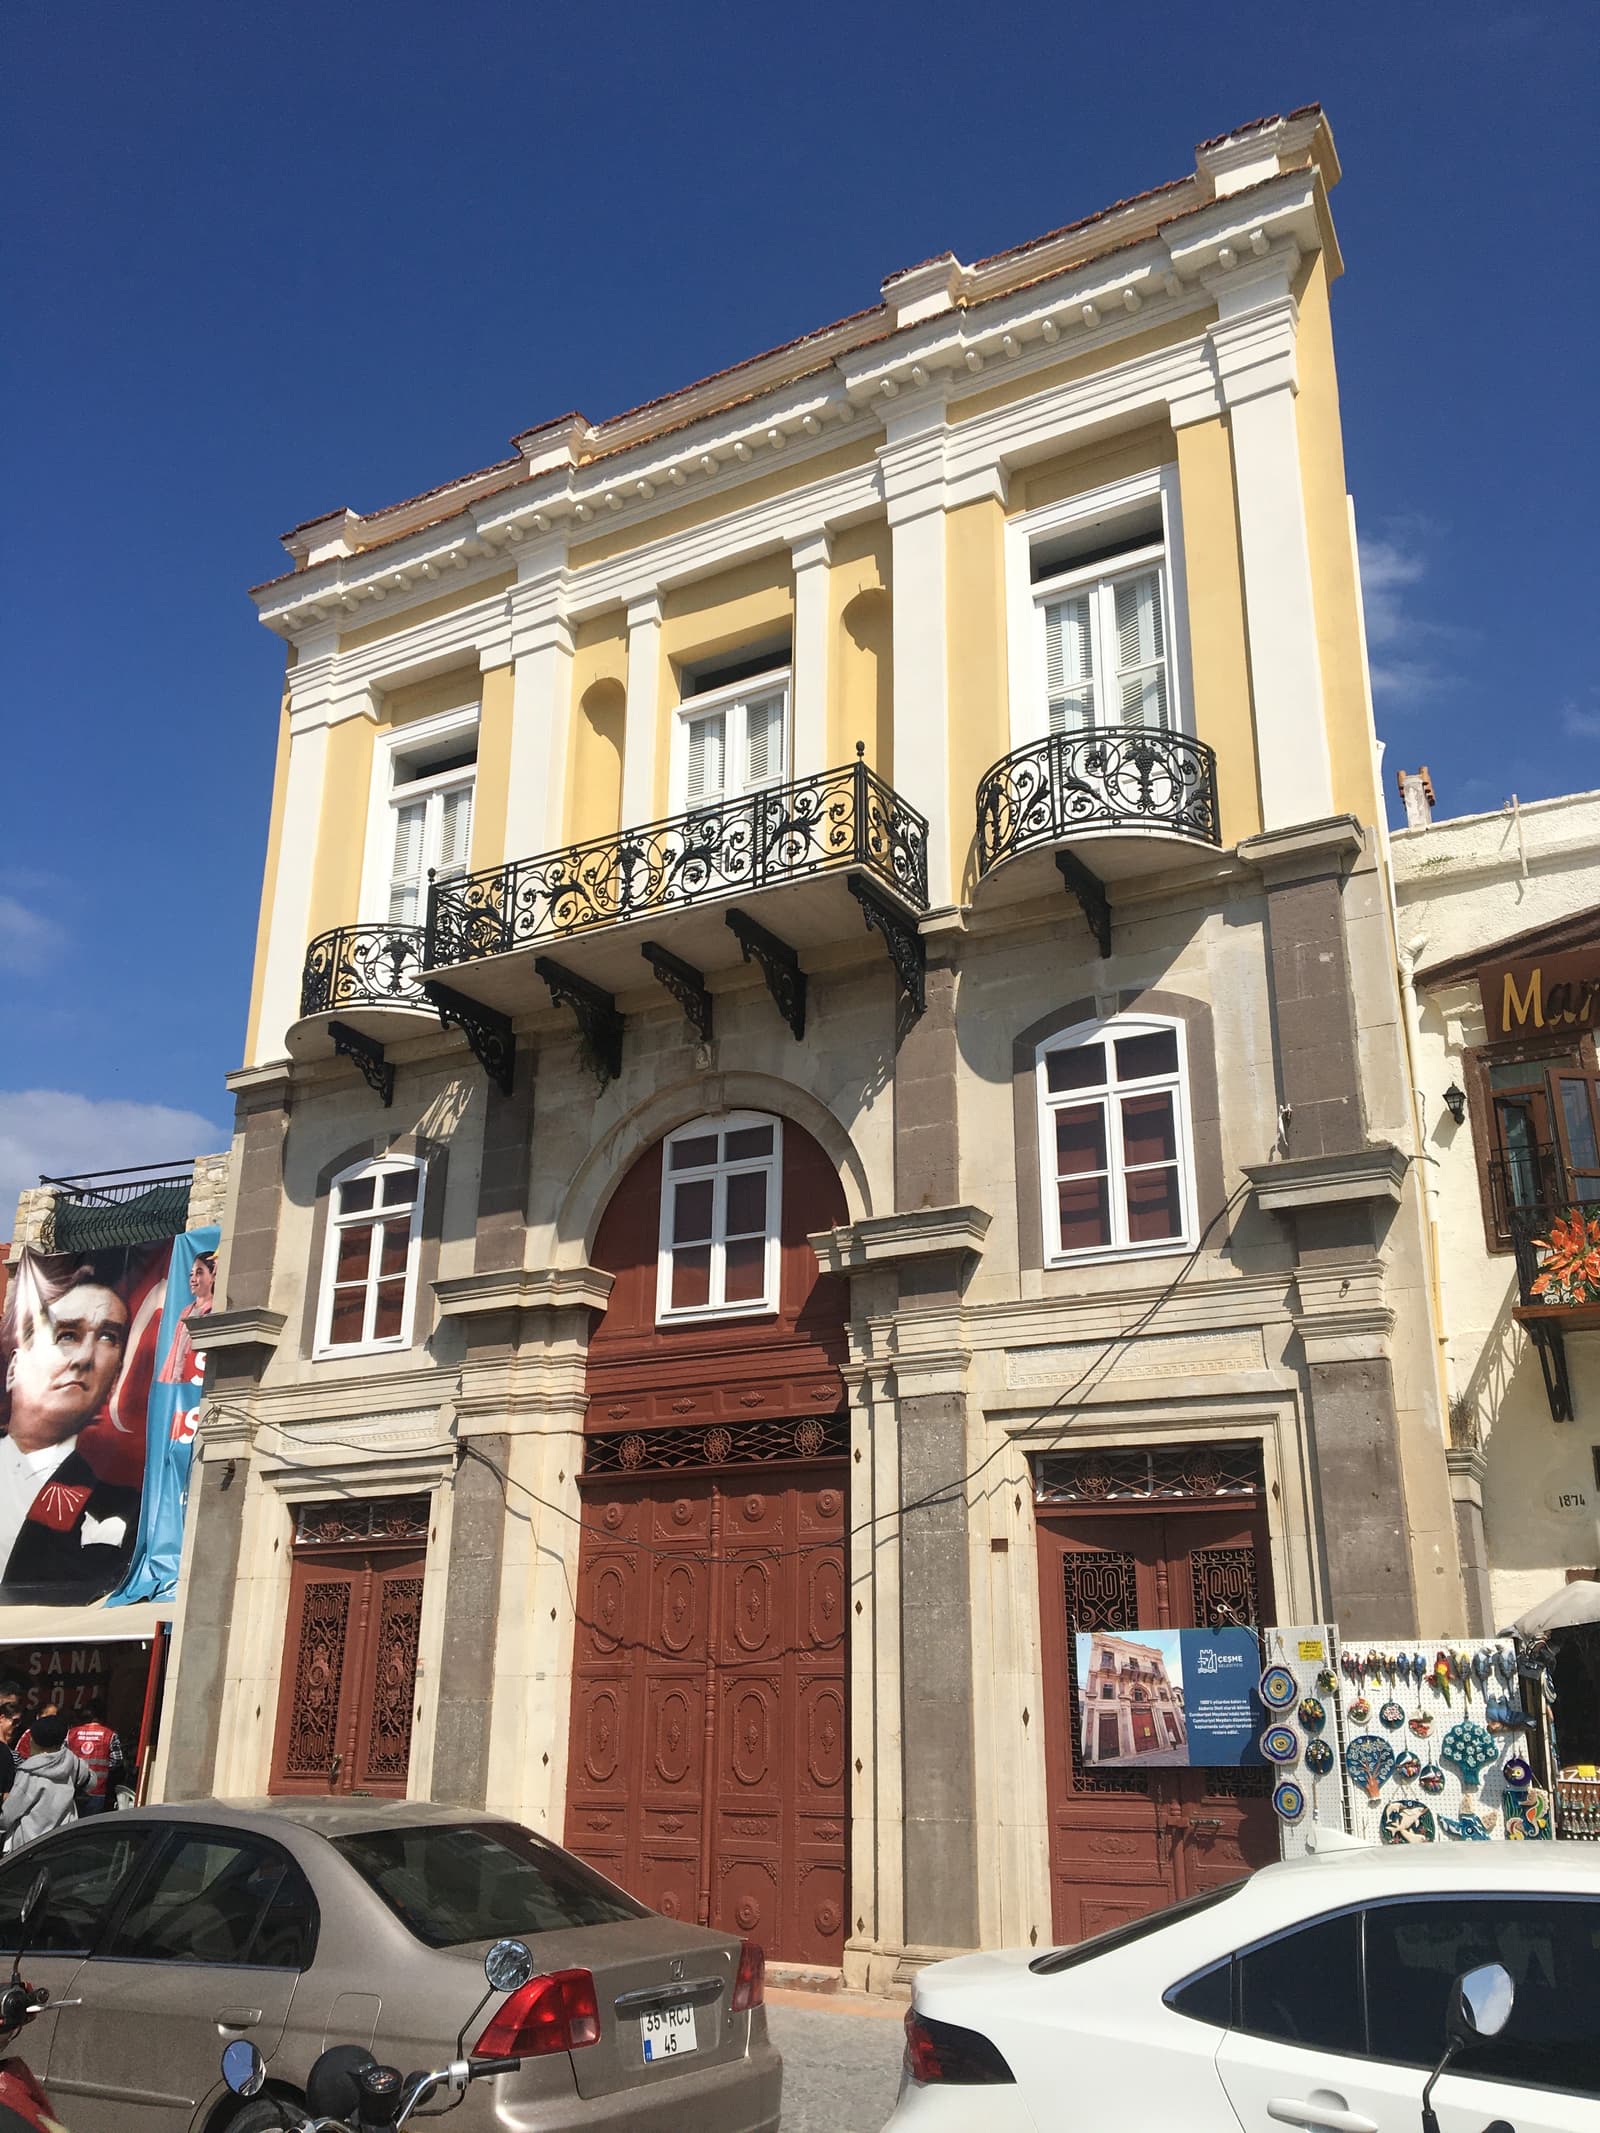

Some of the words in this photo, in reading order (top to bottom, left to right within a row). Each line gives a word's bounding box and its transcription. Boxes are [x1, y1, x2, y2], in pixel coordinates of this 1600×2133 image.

[28, 1650, 102, 1675] SANA
[646, 2013, 660, 2032] 35
[669, 2005, 691, 2026] RCJ
[664, 2034, 677, 2054] 45
